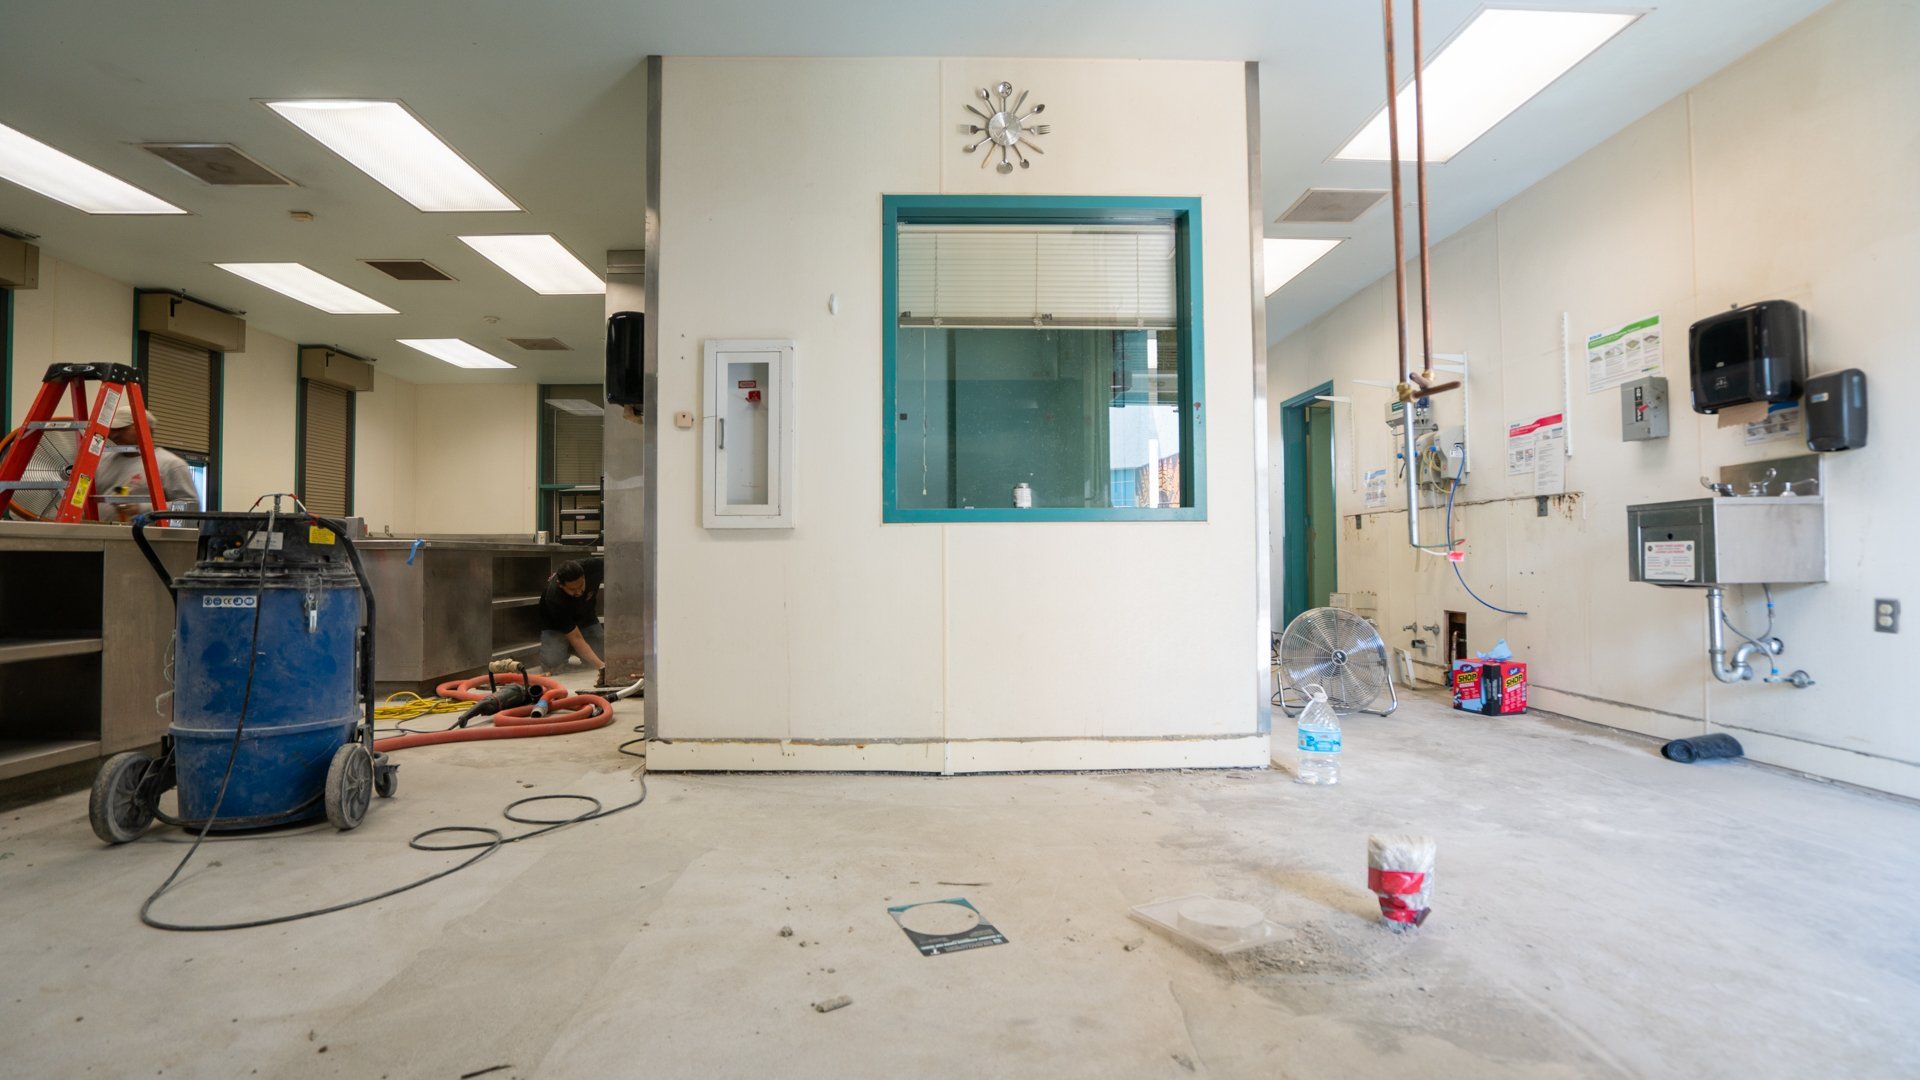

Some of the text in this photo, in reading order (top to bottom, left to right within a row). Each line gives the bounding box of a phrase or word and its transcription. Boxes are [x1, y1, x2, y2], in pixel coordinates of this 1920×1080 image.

[223, 597, 232, 605] CE
[1458, 674, 1477, 682] SHOP
[1506, 674, 1523, 687] SHOP
